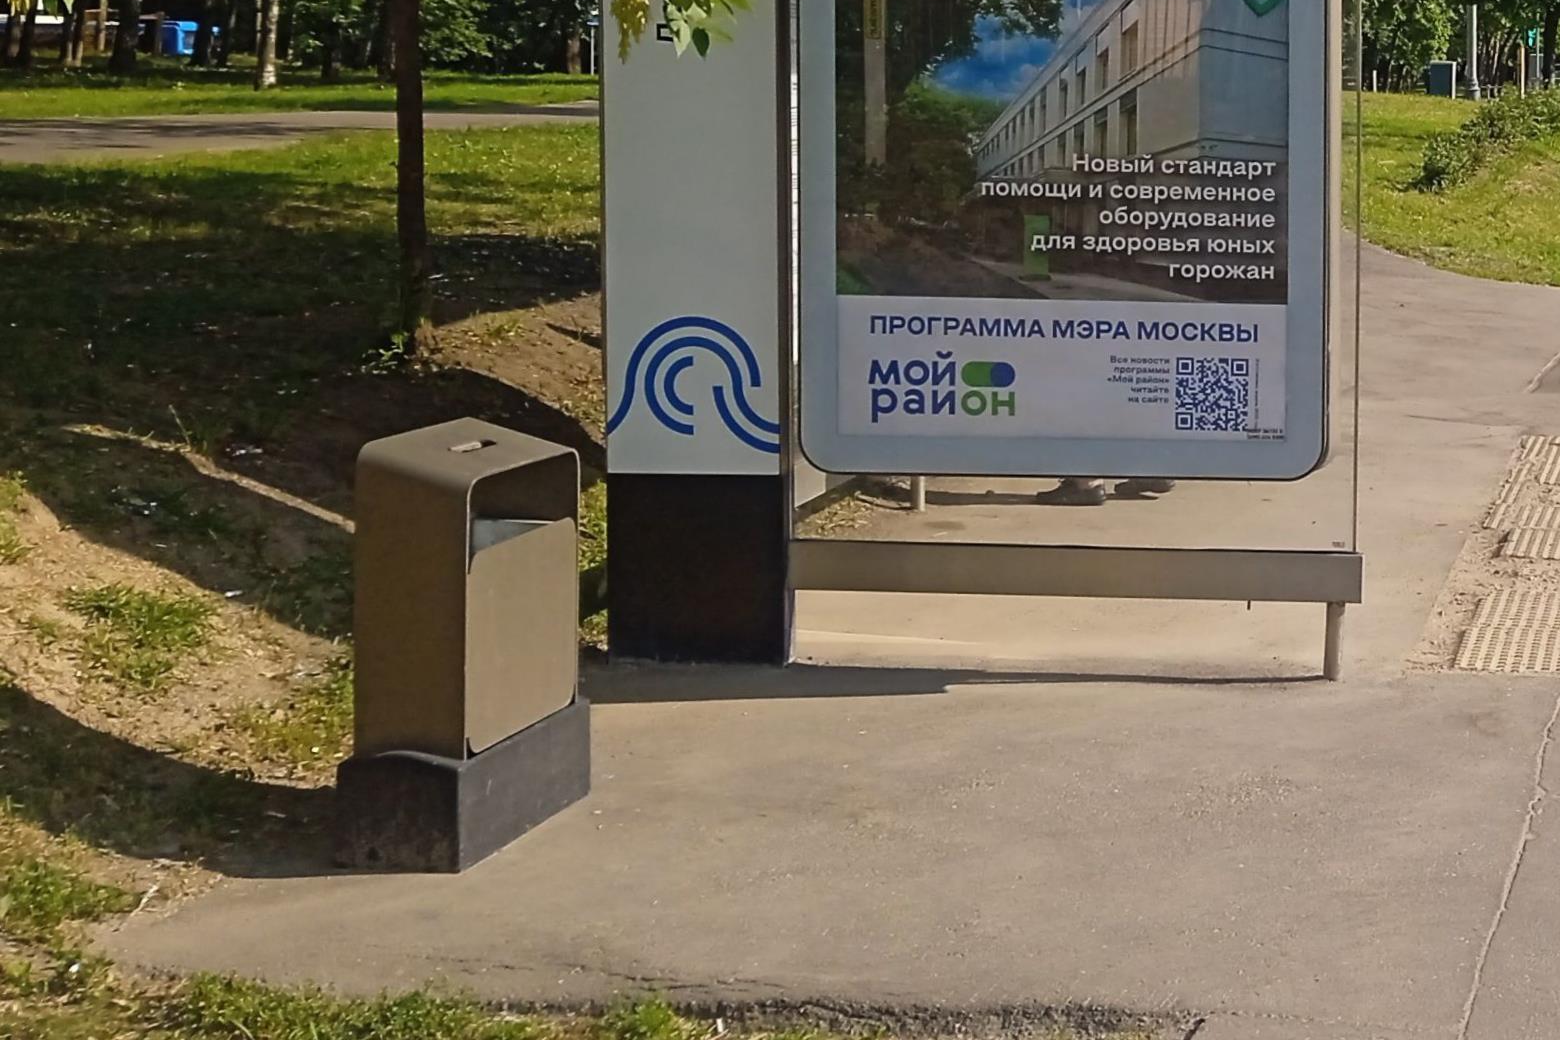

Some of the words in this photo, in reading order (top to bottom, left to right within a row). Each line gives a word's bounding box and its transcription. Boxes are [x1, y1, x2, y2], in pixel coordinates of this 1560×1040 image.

[1071, 153, 1155, 174] Новый
[1160, 158, 1277, 180] стандарт
[980, 181, 1083, 200] помощи
[1088, 184, 1103, 199] и
[1109, 185, 1277, 204] современное
[1099, 206, 1277, 230] оборудование
[1030, 234, 1076, 252] для
[1082, 236, 1200, 255] здоровья
[1206, 239, 1276, 254] юных
[1168, 263, 1276, 283] горожан
[869, 315, 1046, 339] ПРОГРАММА
[1052, 319, 1132, 341] МЭРА
[1137, 321, 1259, 343] МОСКВЫ
[868, 350, 956, 386] мой
[1110, 355, 1128, 364] Все
[1107, 374, 1134, 383] «Мой
[1135, 375, 1170, 385] район»
[1113, 366, 1170, 374] программы
[1130, 385, 1169, 393] читайте
[1141, 395, 1169, 403] сайте
